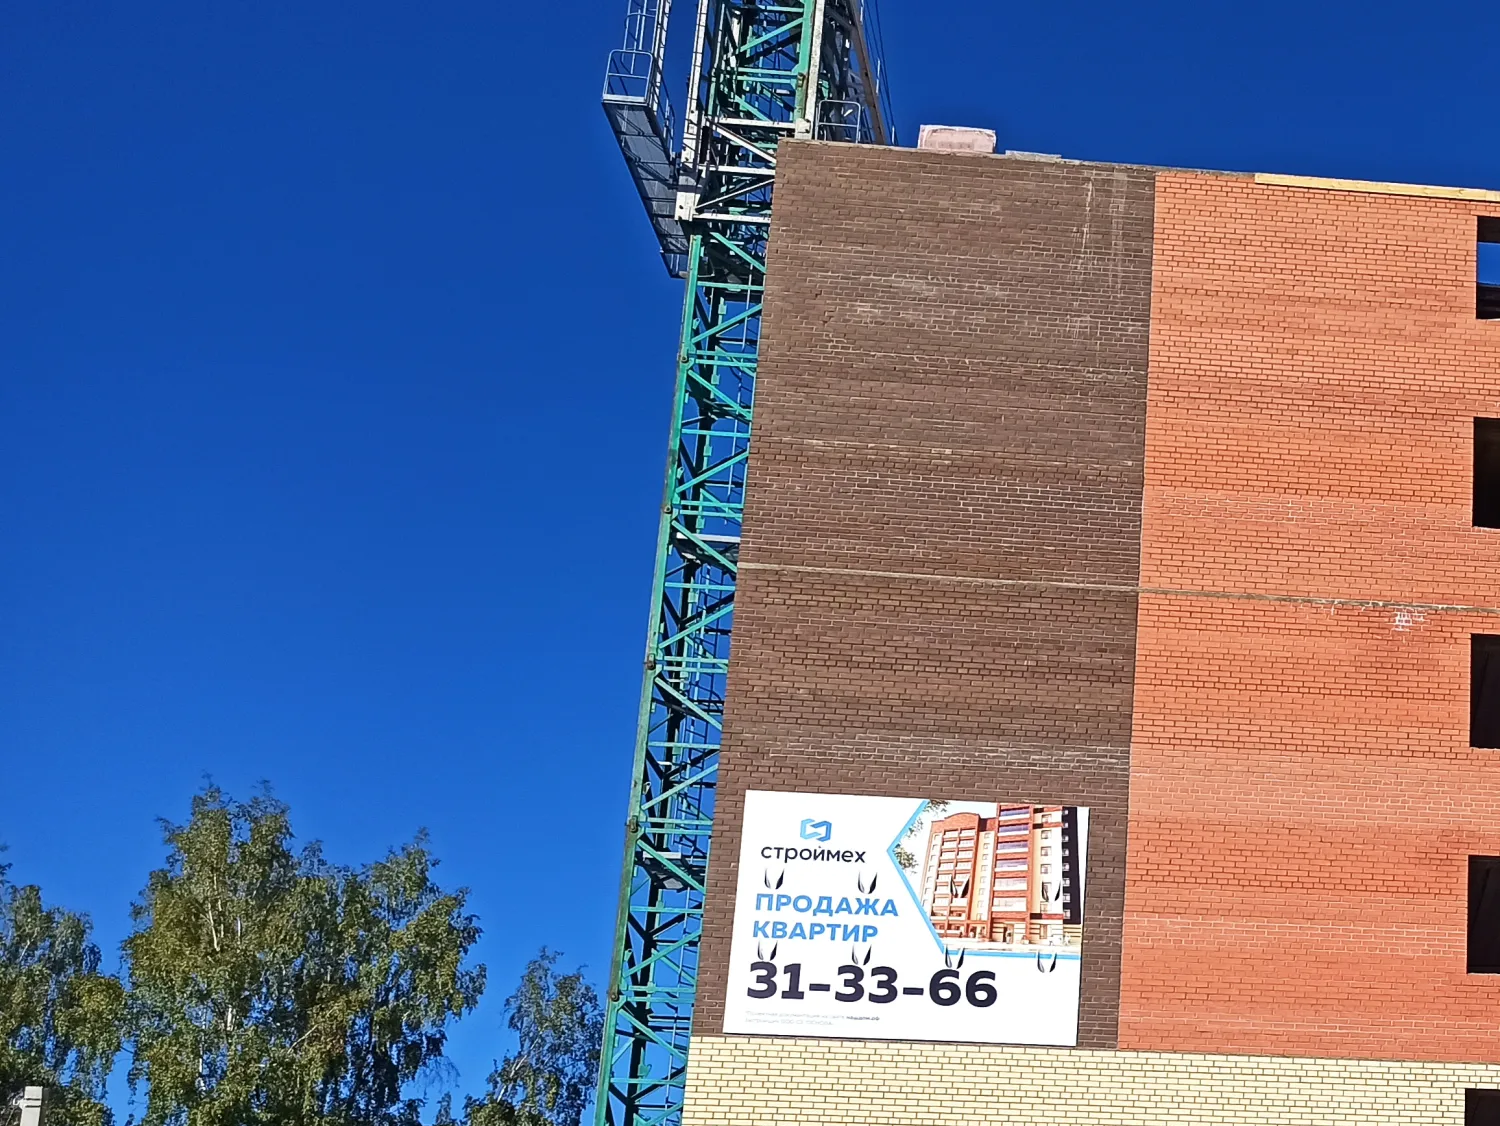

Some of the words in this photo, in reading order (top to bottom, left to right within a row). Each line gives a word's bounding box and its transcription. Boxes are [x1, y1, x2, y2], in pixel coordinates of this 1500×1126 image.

[760, 845, 867, 864] строймех
[755, 893, 899, 917] ПРОДАЖА
[752, 920, 879, 943] КВАРТИР
[747, 960, 998, 1008] 31-33-66
